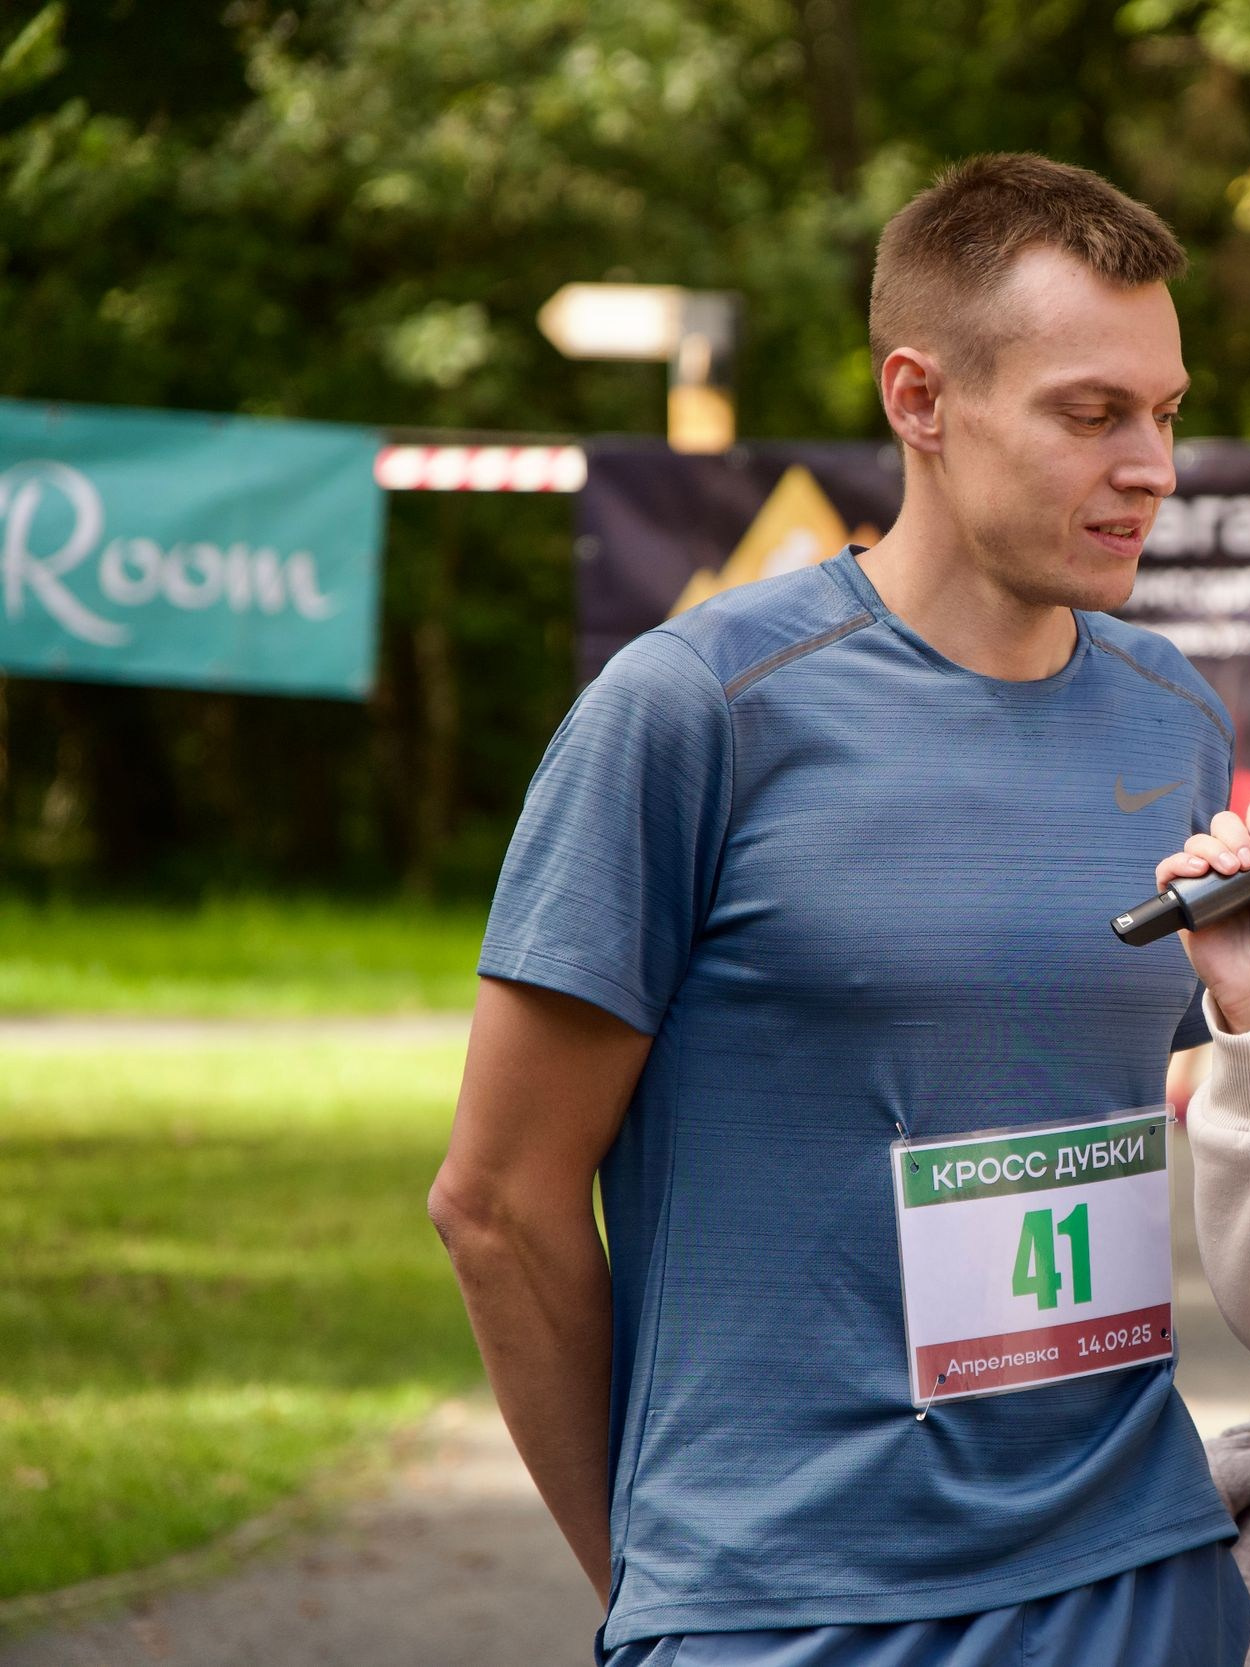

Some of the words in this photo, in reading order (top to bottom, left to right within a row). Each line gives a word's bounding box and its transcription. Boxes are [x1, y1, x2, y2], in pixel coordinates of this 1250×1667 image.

[2, 460, 342, 648] Room
[932, 1152, 1047, 1190] КРОСС
[1055, 1135, 1144, 1179] ДУБКИ
[1012, 1203, 1092, 1311] 41
[946, 1345, 1059, 1378] Апрелевка
[1078, 1324, 1152, 1357] 14.09.25
